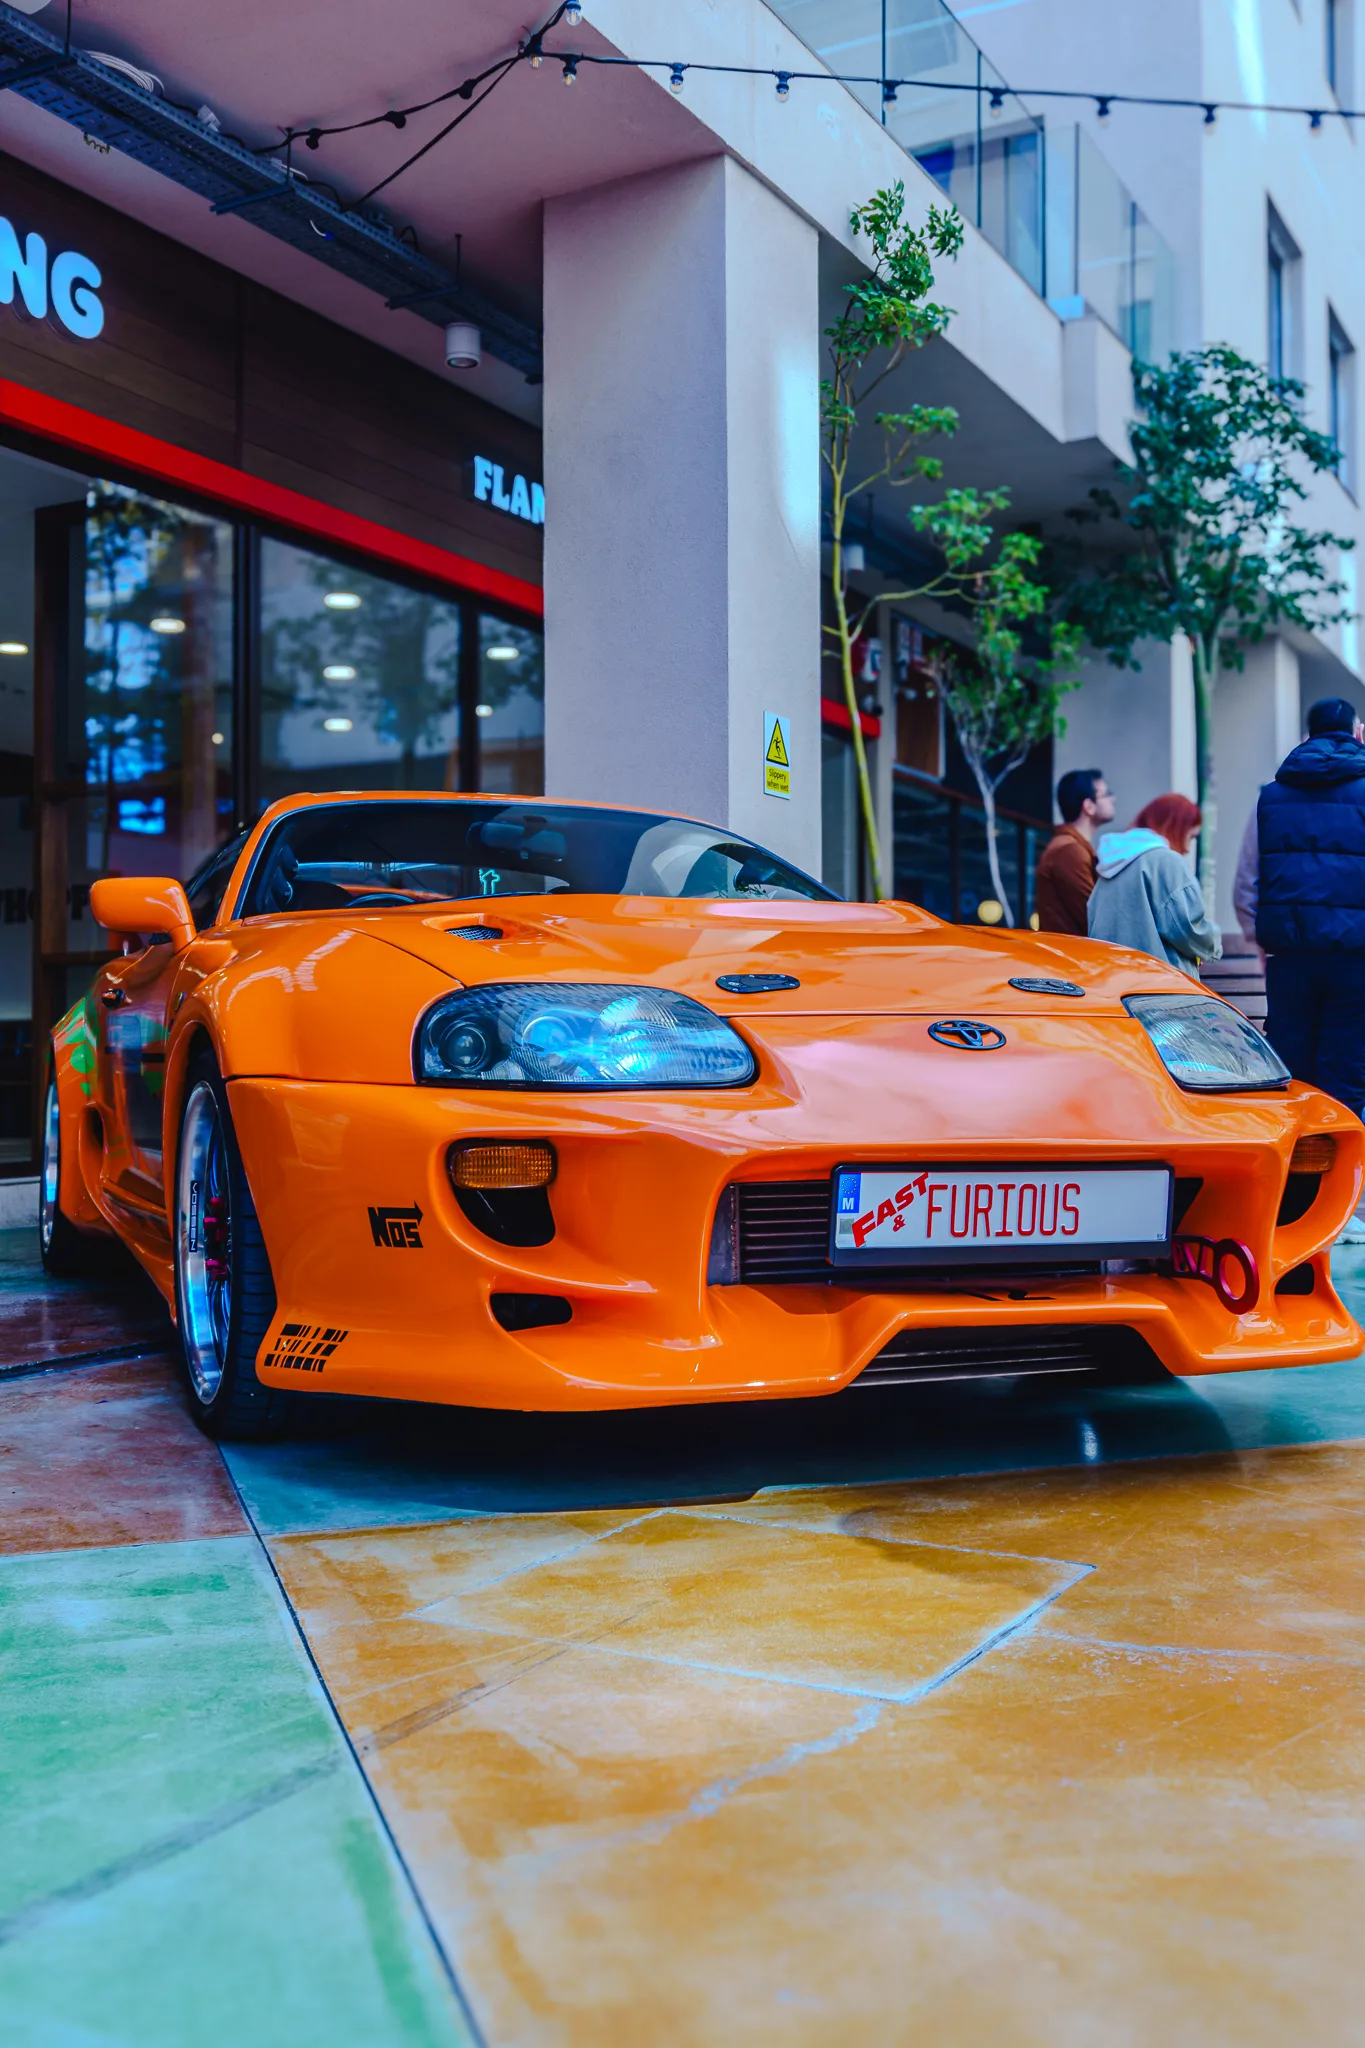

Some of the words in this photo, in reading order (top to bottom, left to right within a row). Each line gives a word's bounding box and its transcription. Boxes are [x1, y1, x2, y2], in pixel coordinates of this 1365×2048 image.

[0, 216, 104, 339] NG
[767, 779, 779, 789] when
[780, 783, 789, 792] wet
[769, 768, 786, 782] Slippery
[842, 1197, 855, 1210] M
[851, 1172, 929, 1248] FAST
[892, 1214, 906, 1232] &
[926, 1183, 1081, 1238] FURIOUS
[367, 1203, 424, 1248] NOS
